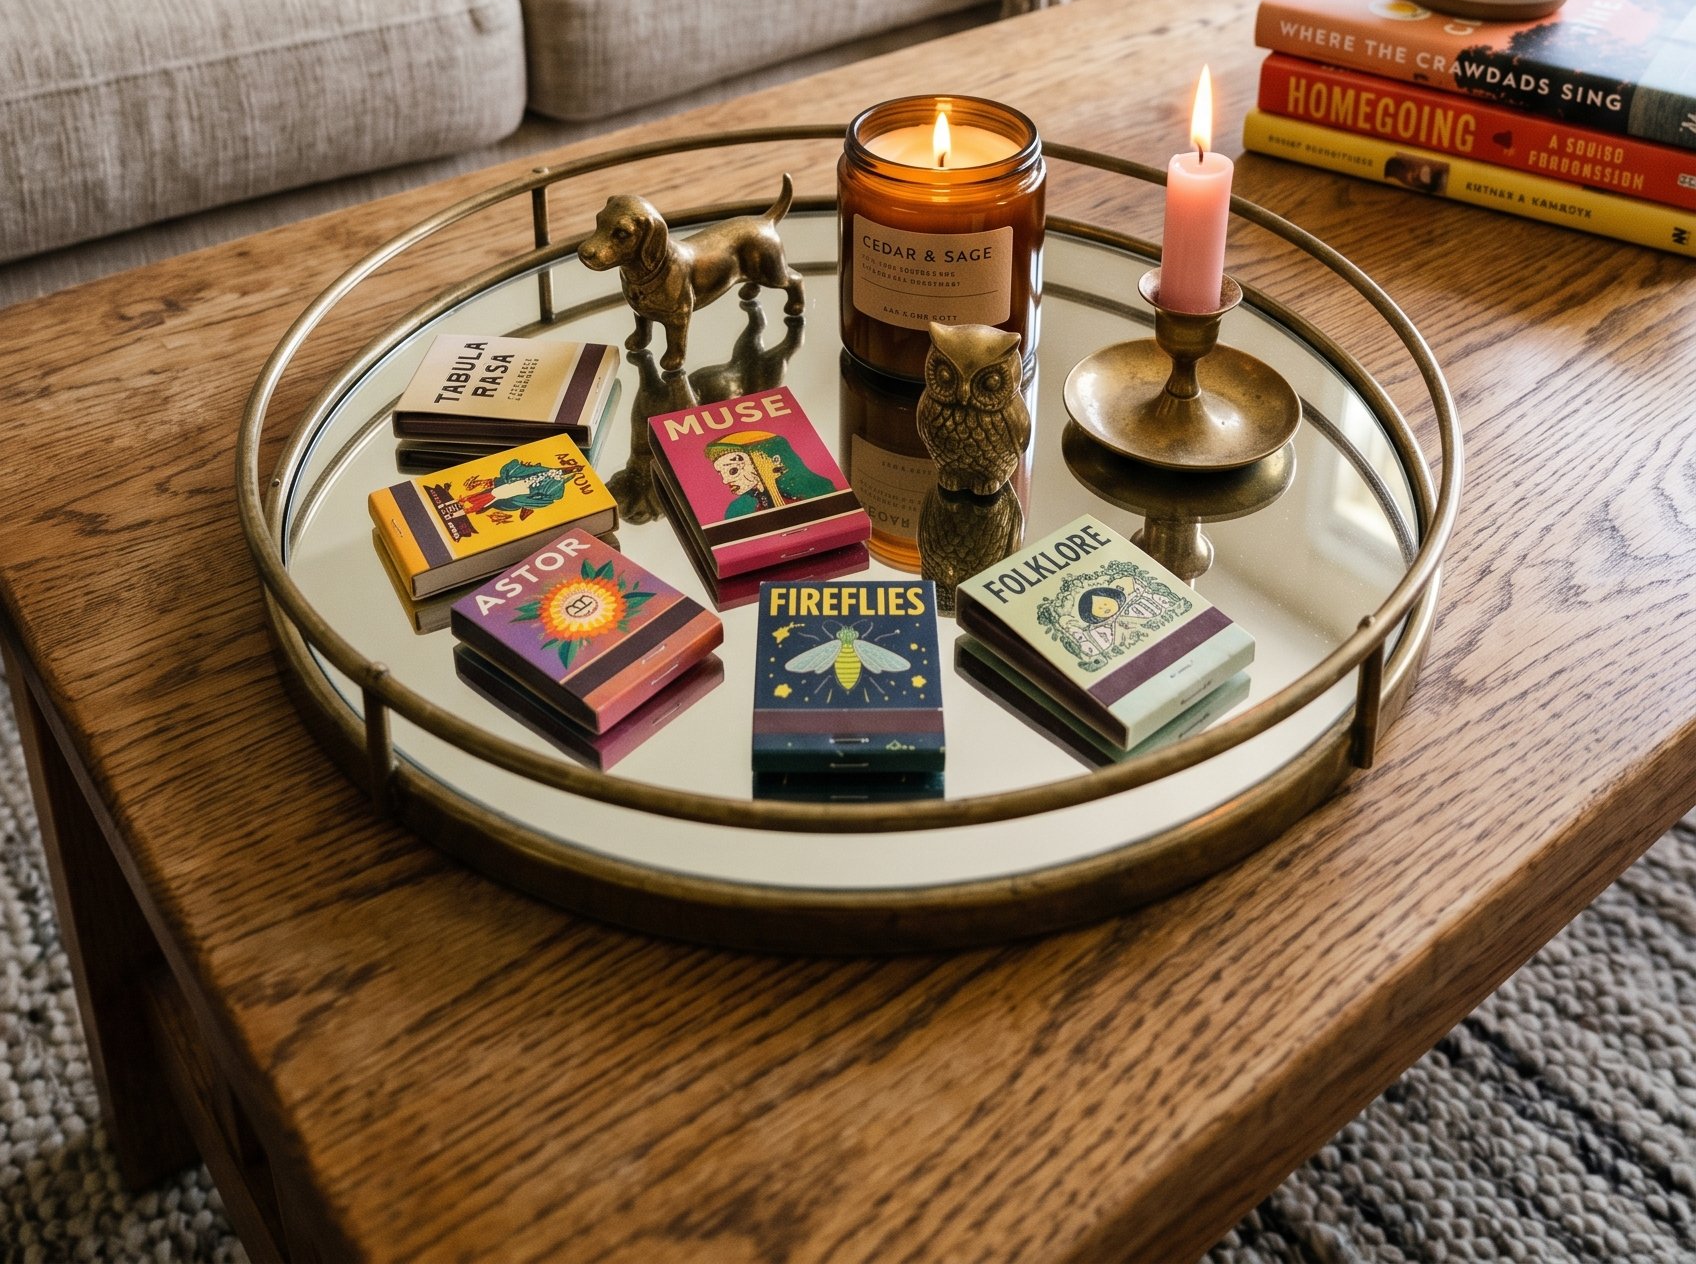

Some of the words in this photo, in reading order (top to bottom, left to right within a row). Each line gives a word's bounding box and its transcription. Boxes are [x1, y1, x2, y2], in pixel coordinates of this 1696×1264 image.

[1280, 20, 1355, 52] WHERE
[1365, 39, 1407, 64] THE
[1416, 52, 1550, 95] CRAWDADS
[1561, 84, 1622, 112] SING
[1287, 76, 1476, 152] HOMEGOING
[862, 235, 917, 261] CEDAR
[924, 249, 936, 262] &
[944, 246, 993, 263] SAGE
[433, 342, 488, 404] TABULA
[471, 354, 515, 398] RASA
[663, 394, 792, 442] MUSE
[474, 537, 591, 616] ASTOR
[982, 525, 1112, 604] FOLKLORE
[769, 587, 926, 617] FIREFLIES
